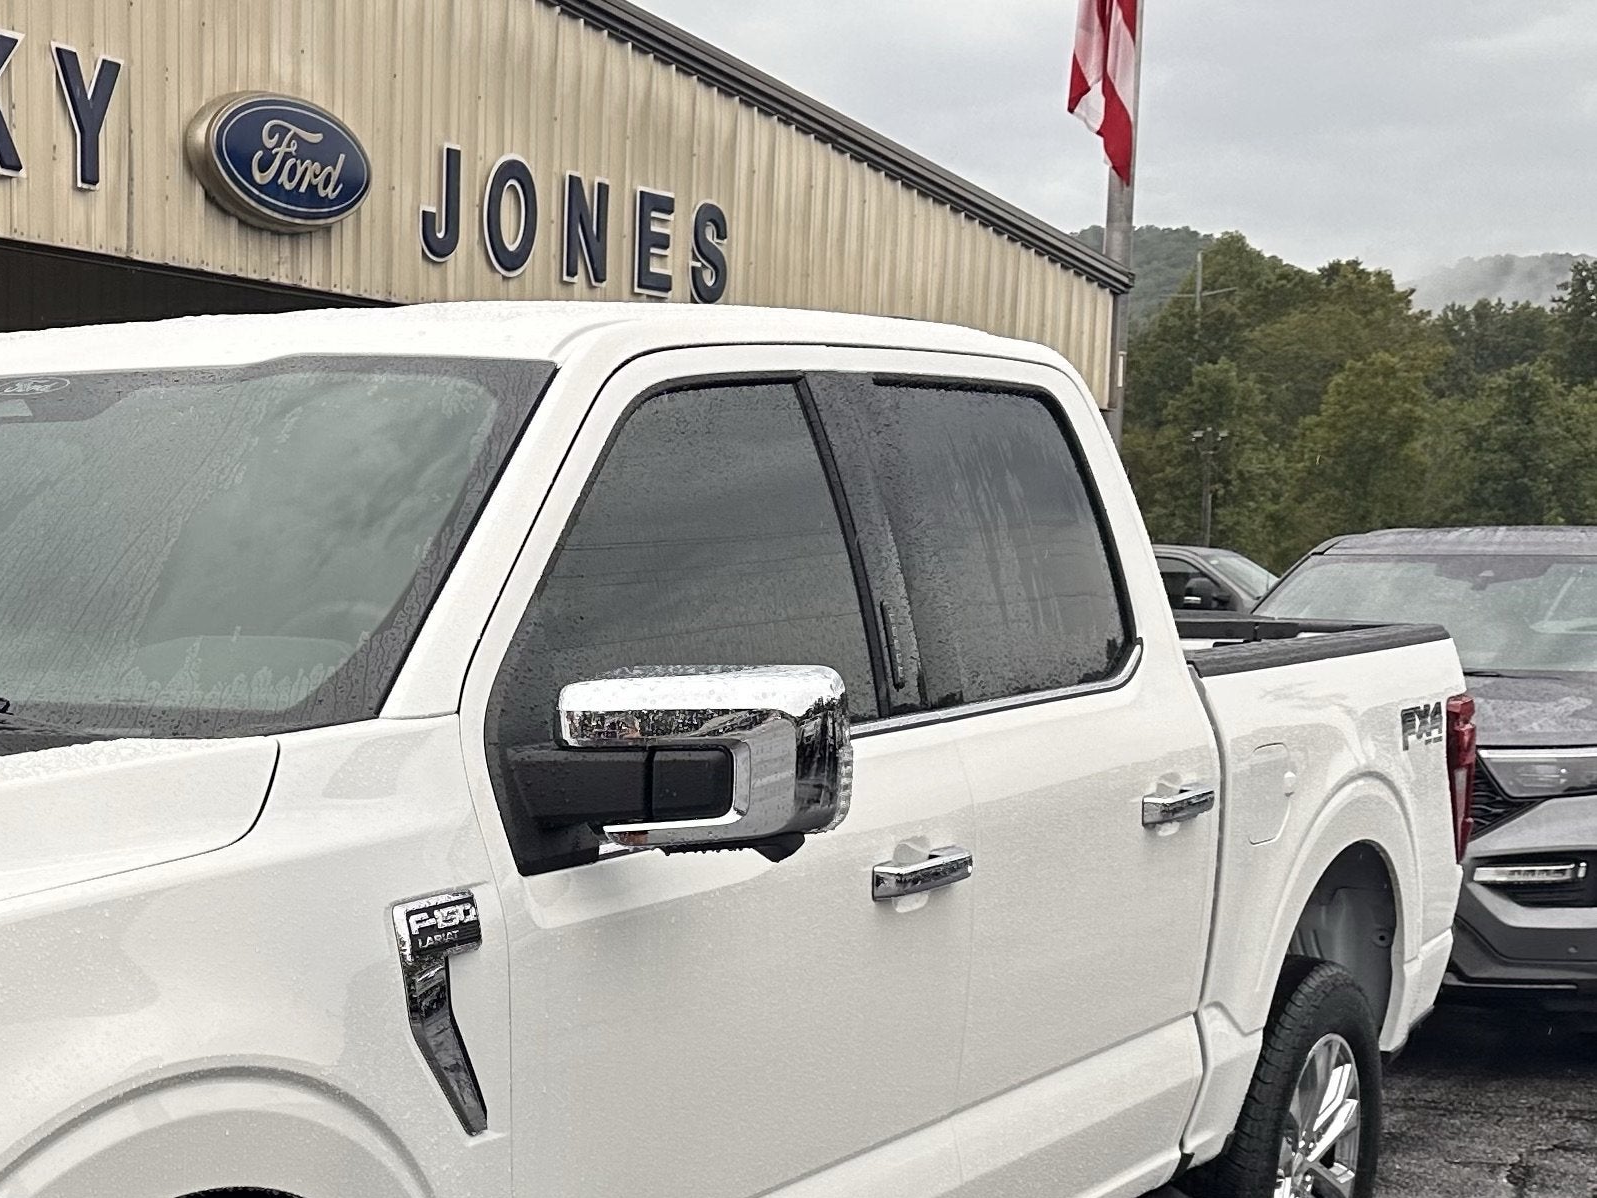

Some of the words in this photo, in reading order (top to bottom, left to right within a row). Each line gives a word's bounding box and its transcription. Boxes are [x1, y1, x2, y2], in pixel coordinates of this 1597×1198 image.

[251, 118, 346, 200] Ford
[419, 142, 729, 304] JONES
[1400, 701, 1443, 751] FX4
[408, 902, 477, 935] F-150
[417, 929, 460, 949] LARIAT
